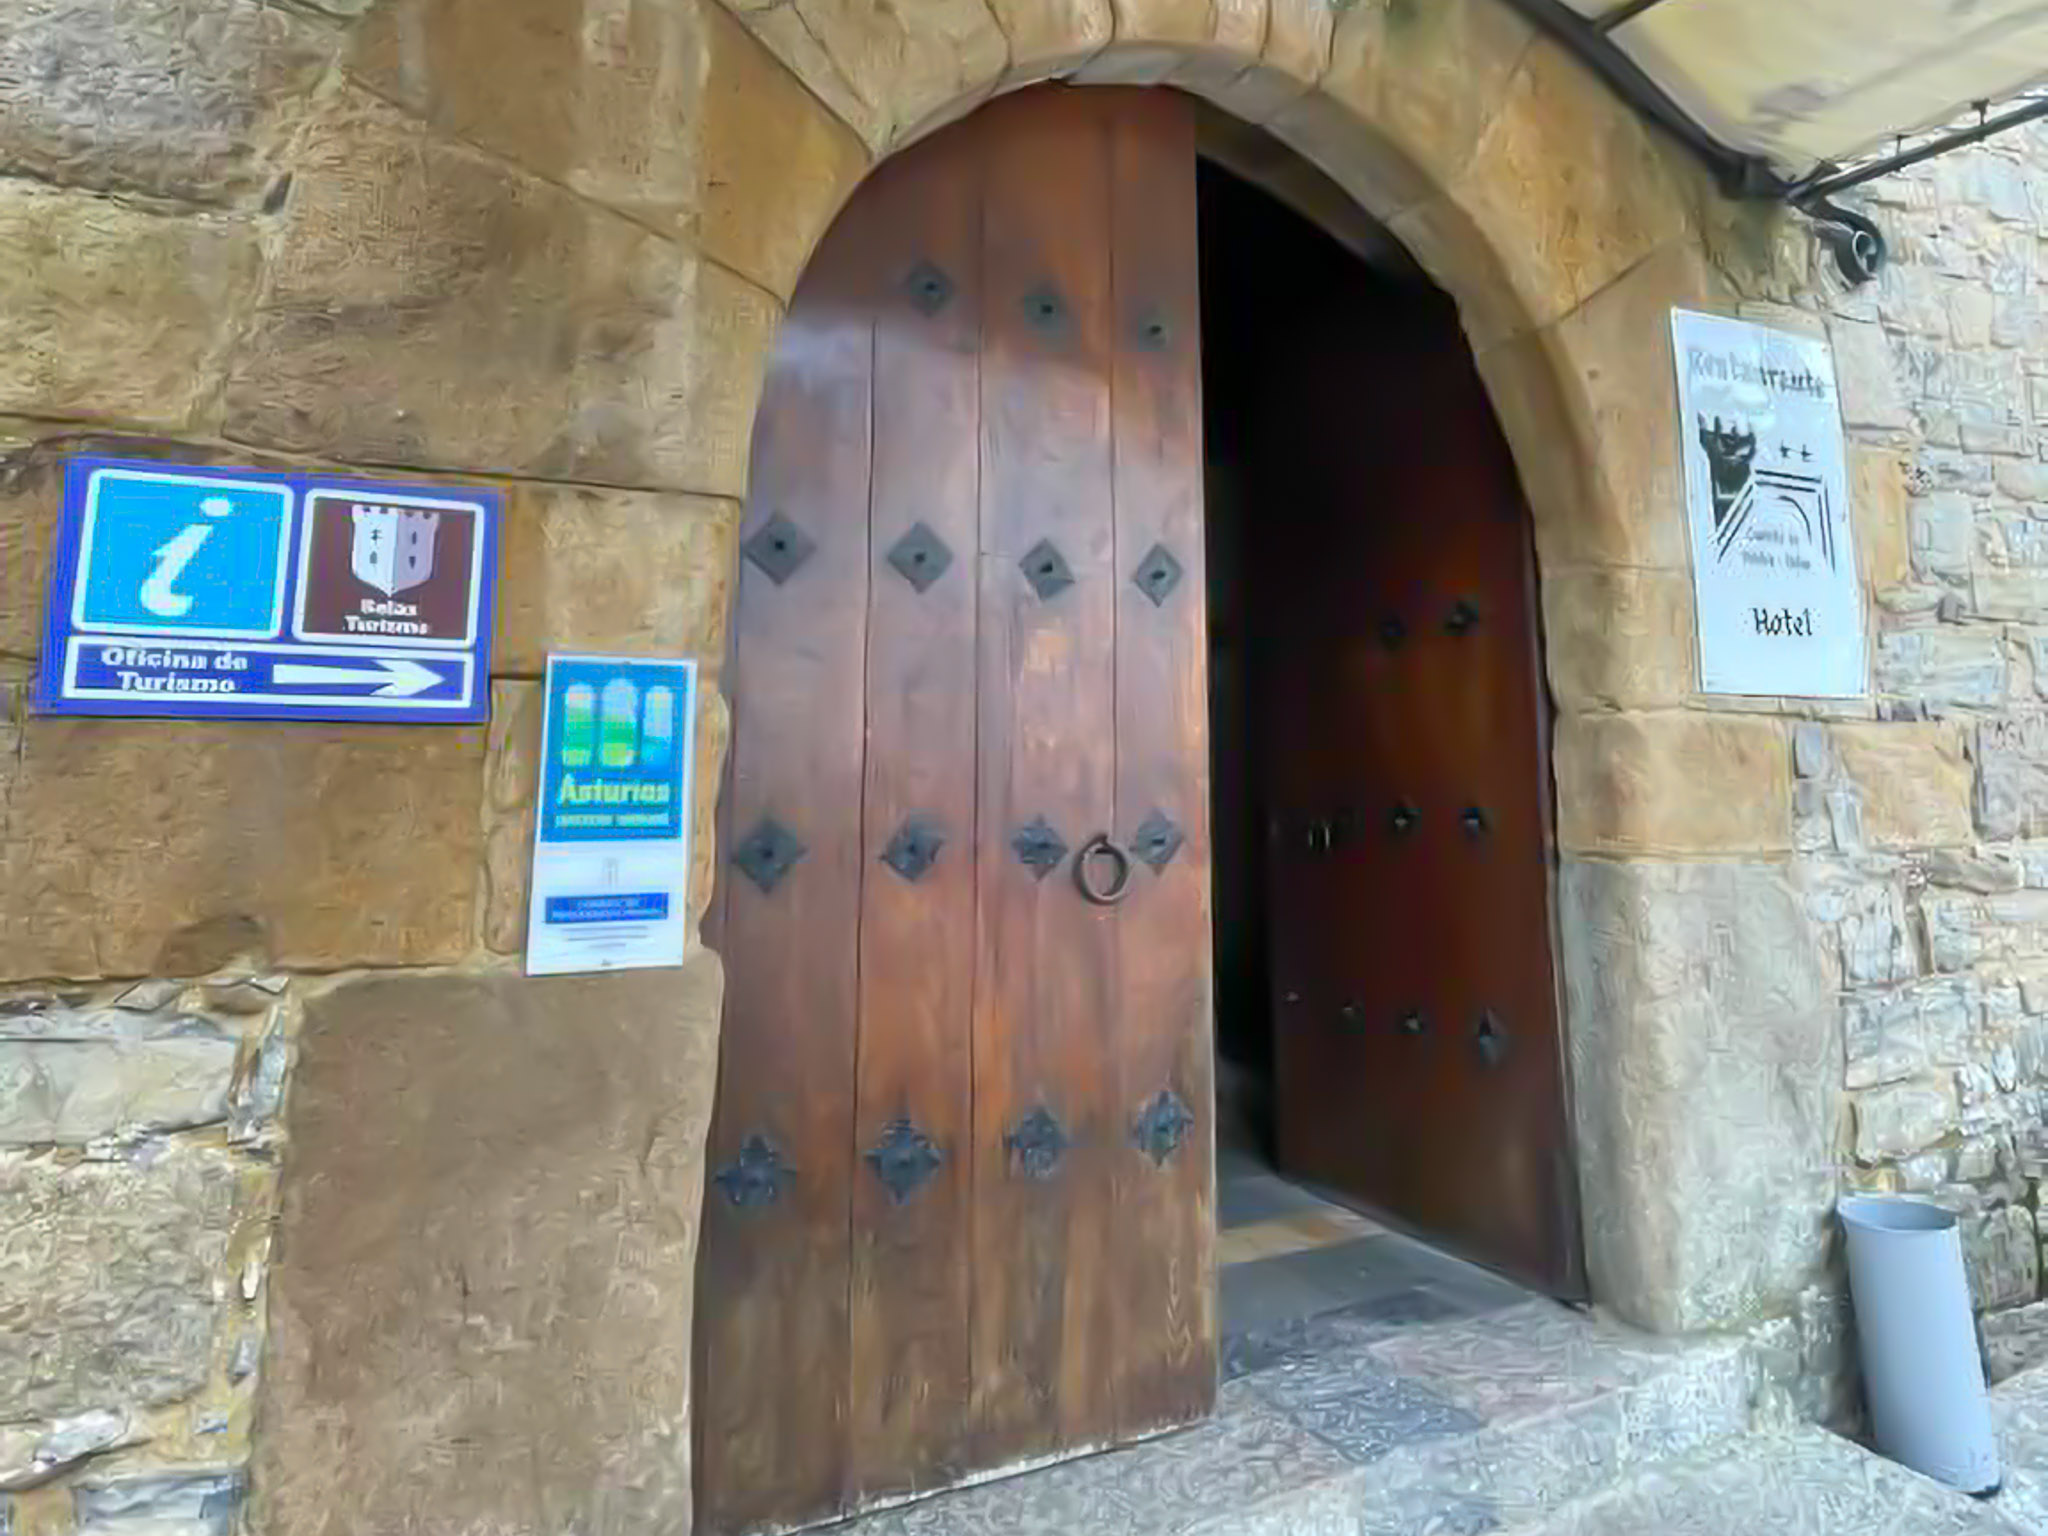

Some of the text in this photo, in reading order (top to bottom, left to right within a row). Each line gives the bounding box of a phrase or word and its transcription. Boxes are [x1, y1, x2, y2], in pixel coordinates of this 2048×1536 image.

[1752, 607, 1813, 636] Hotel
[101, 647, 248, 670] Oficina de
[117, 671, 236, 692] Turismo
[557, 773, 669, 805] Asturias
